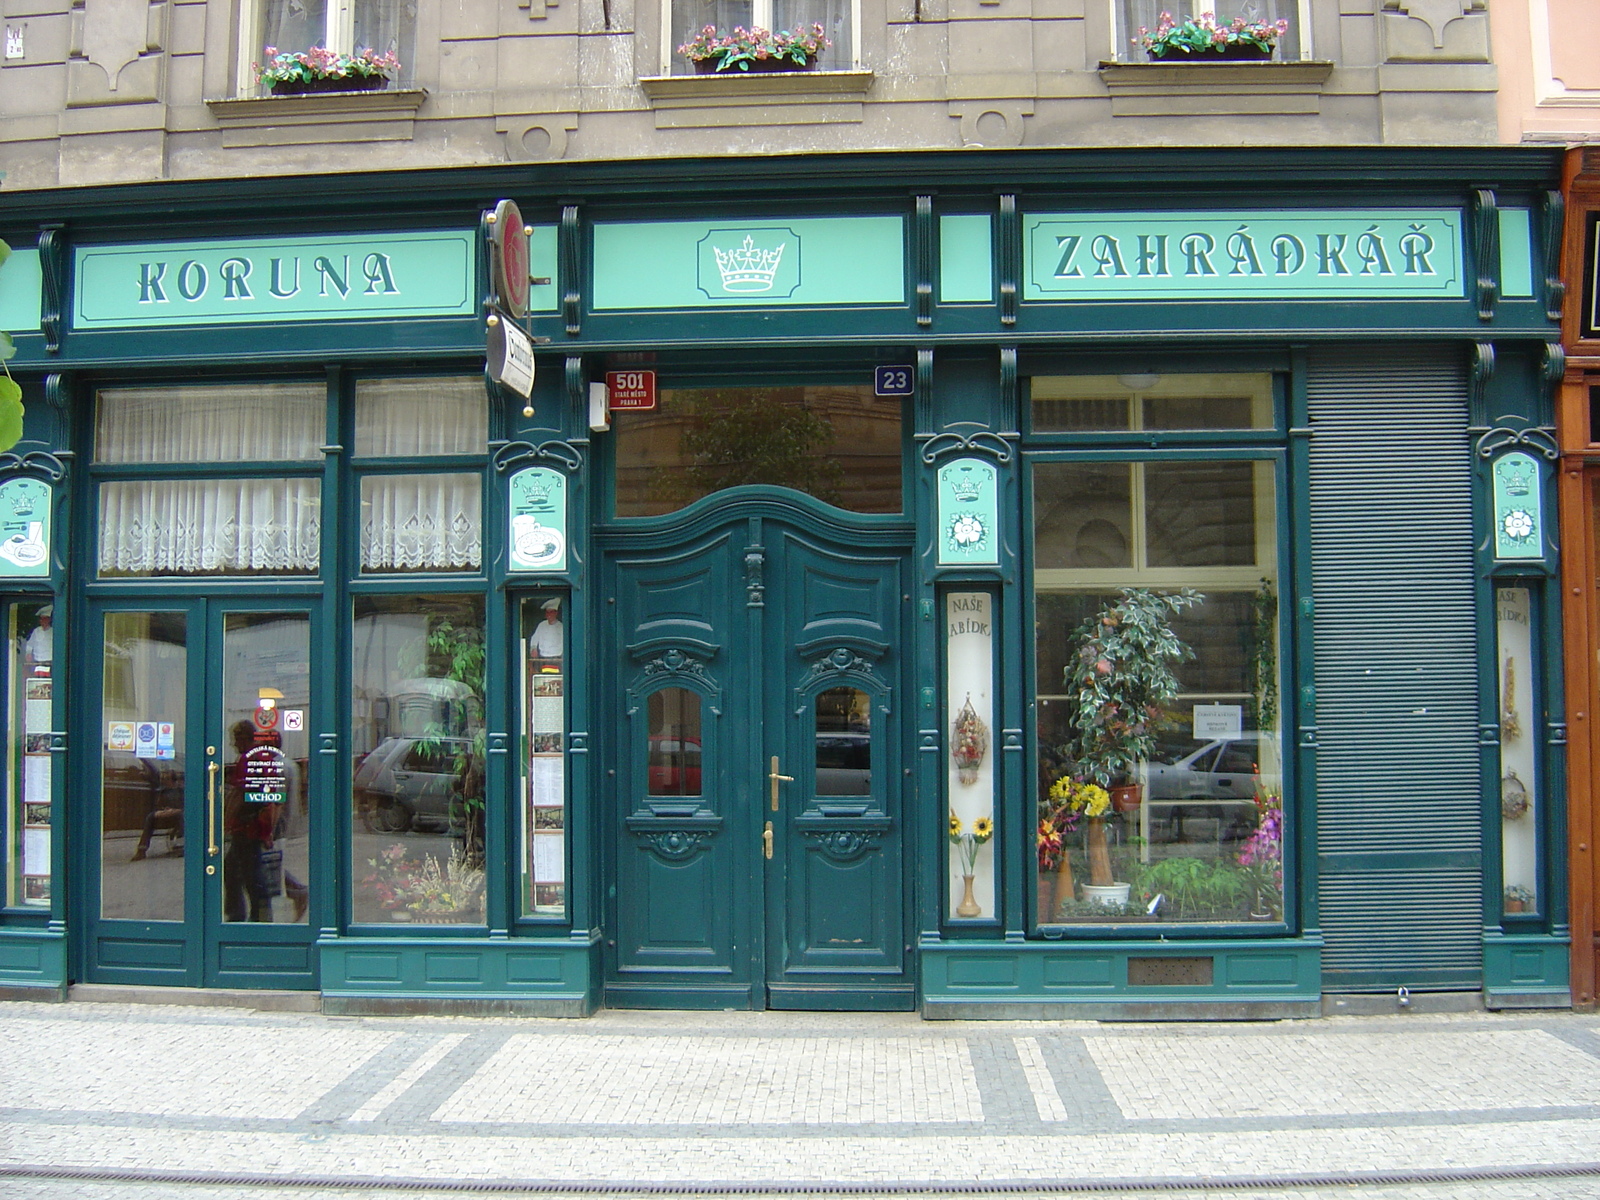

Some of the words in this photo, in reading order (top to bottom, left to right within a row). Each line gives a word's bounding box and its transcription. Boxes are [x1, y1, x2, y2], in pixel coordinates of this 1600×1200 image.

[1053, 224, 1437, 278] ZAHRÁDKÁŘ
[136, 252, 401, 304] KORUNA
[616, 373, 644, 389] 501
[883, 371, 907, 389] 23
[614, 390, 630, 398] STARÉ
[630, 389, 647, 398] MĚSTO
[952, 595, 983, 613] NAŠE
[249, 793, 282, 802] VCHOD
